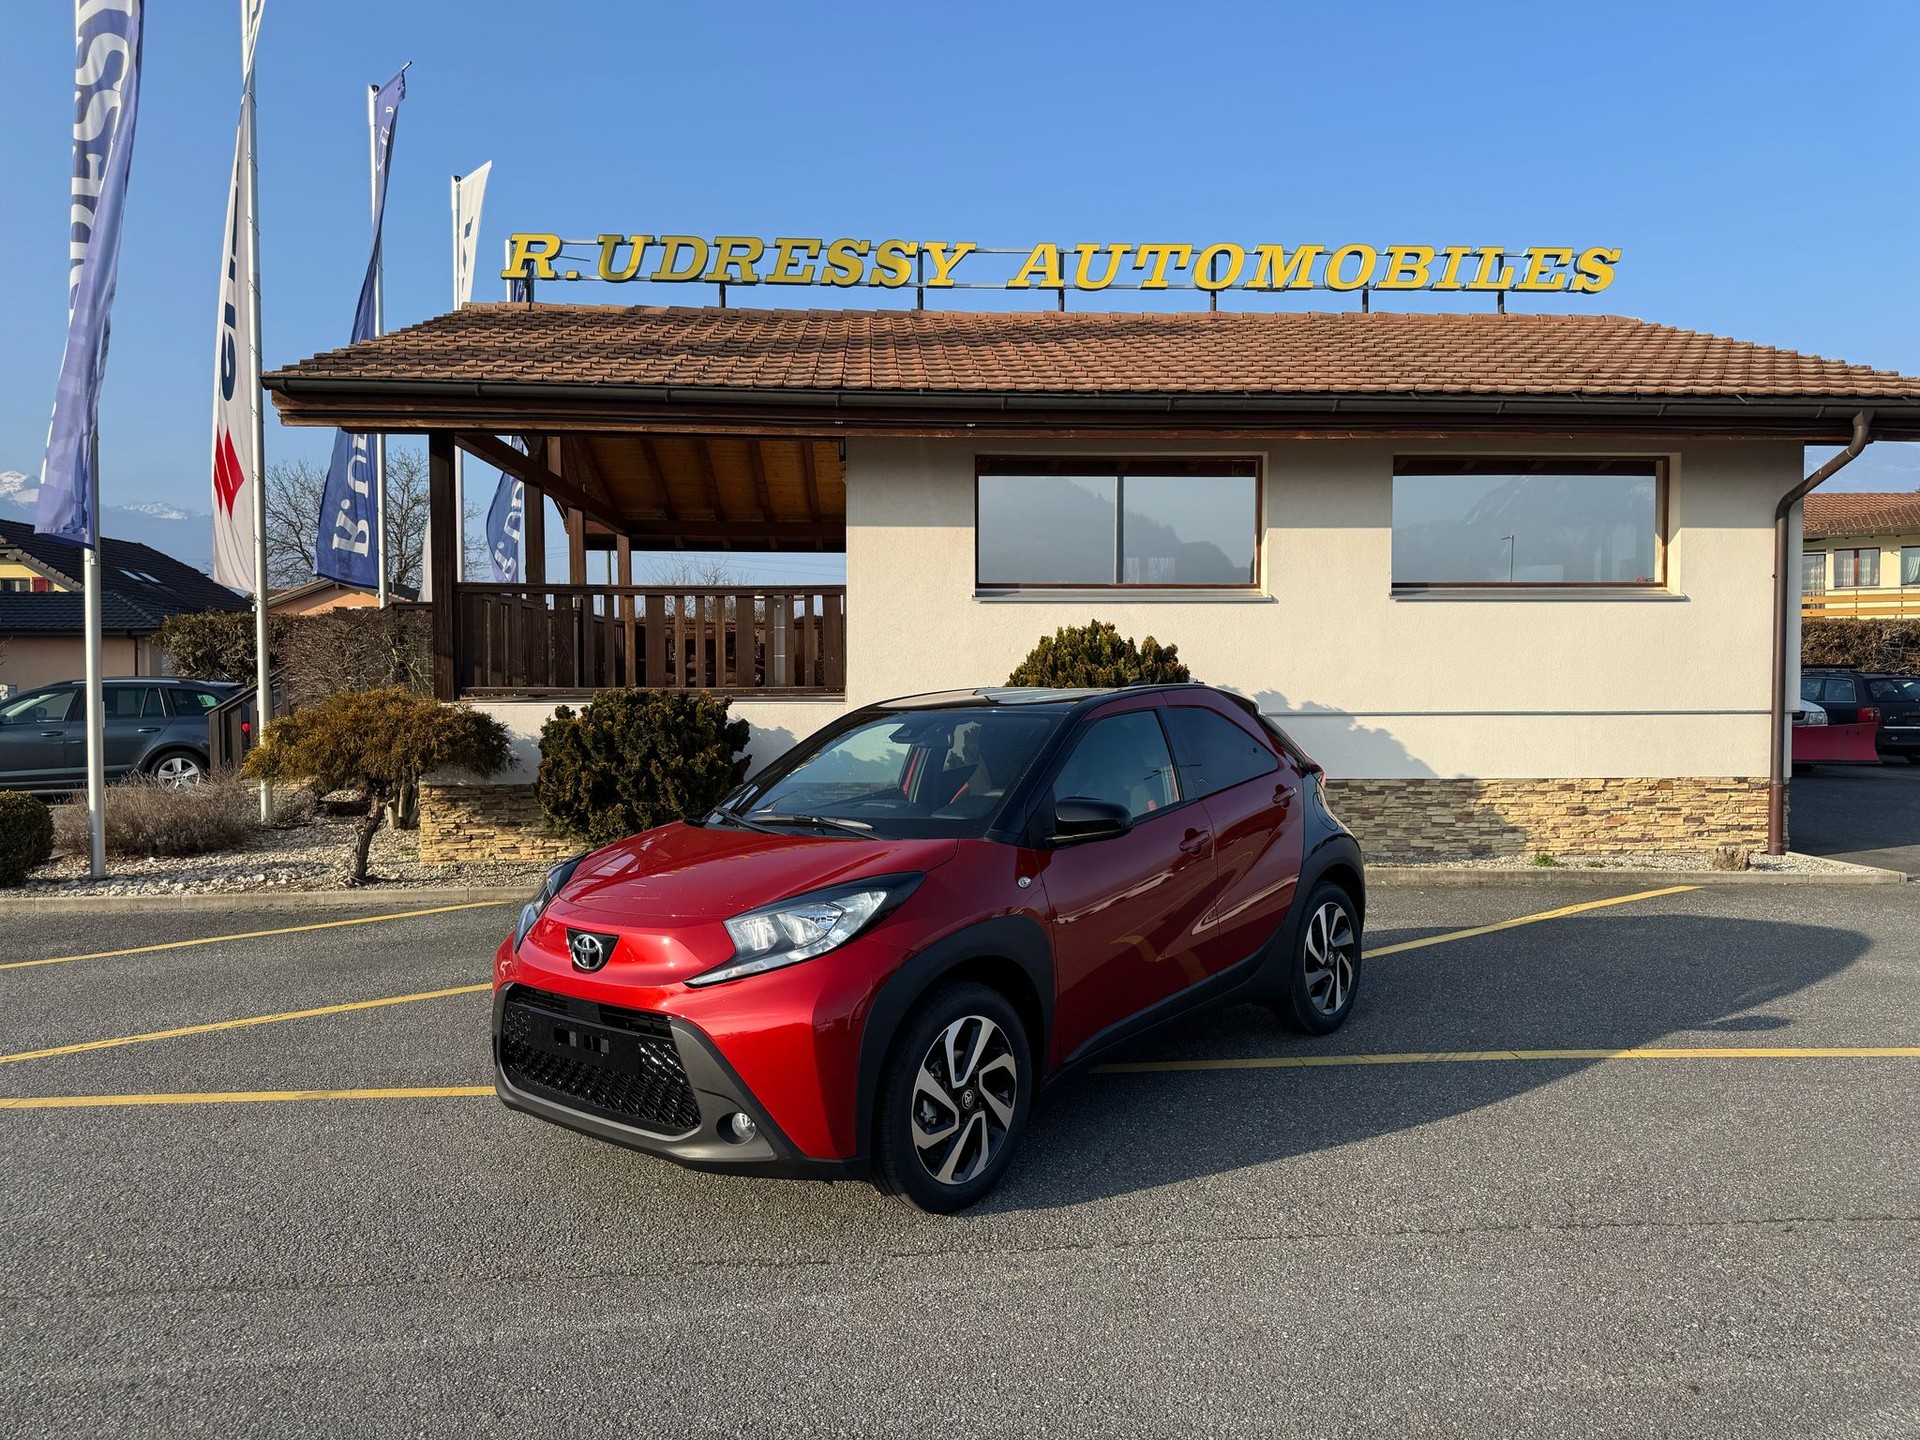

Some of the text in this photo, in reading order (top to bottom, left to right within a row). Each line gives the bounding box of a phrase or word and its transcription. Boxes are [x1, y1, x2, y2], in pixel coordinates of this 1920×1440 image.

[501, 232, 578, 281] R.
[596, 234, 977, 289] UDRESSY
[1006, 242, 1623, 294] AUTOMOBILES
